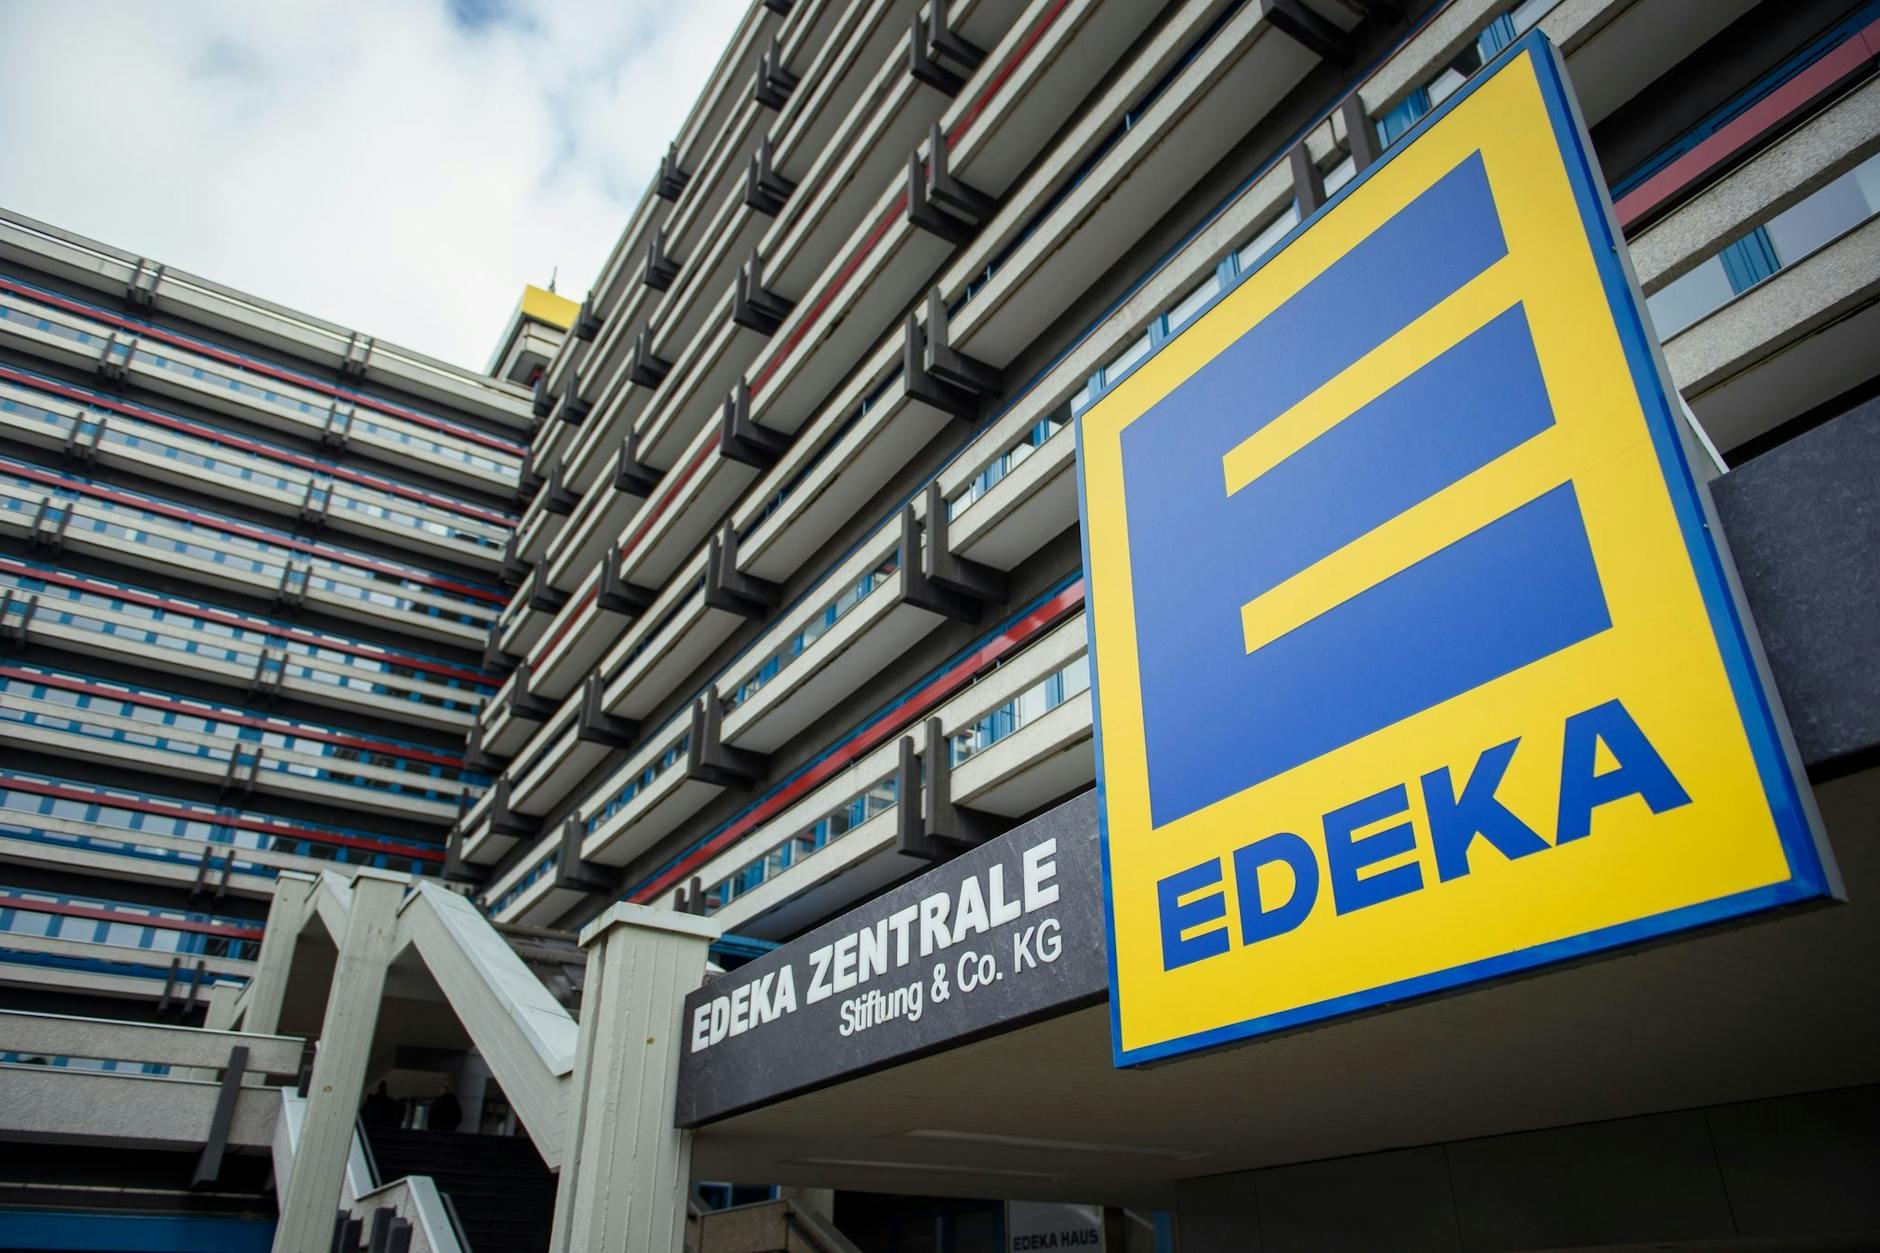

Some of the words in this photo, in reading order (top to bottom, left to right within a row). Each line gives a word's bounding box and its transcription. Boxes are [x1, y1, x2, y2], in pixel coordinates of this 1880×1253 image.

[1157, 698, 1693, 972] EDEKA
[691, 964, 798, 1054] EDEKA
[806, 838, 1060, 1005] ZENTRALE
[838, 980, 923, 1037] Stiftung
[931, 963, 951, 1003] &
[957, 950, 1003, 993] Co.
[1013, 918, 1063, 974] KG
[1013, 1232, 1058, 1251] EDEKA
[1060, 1228, 1098, 1247] HAUS
